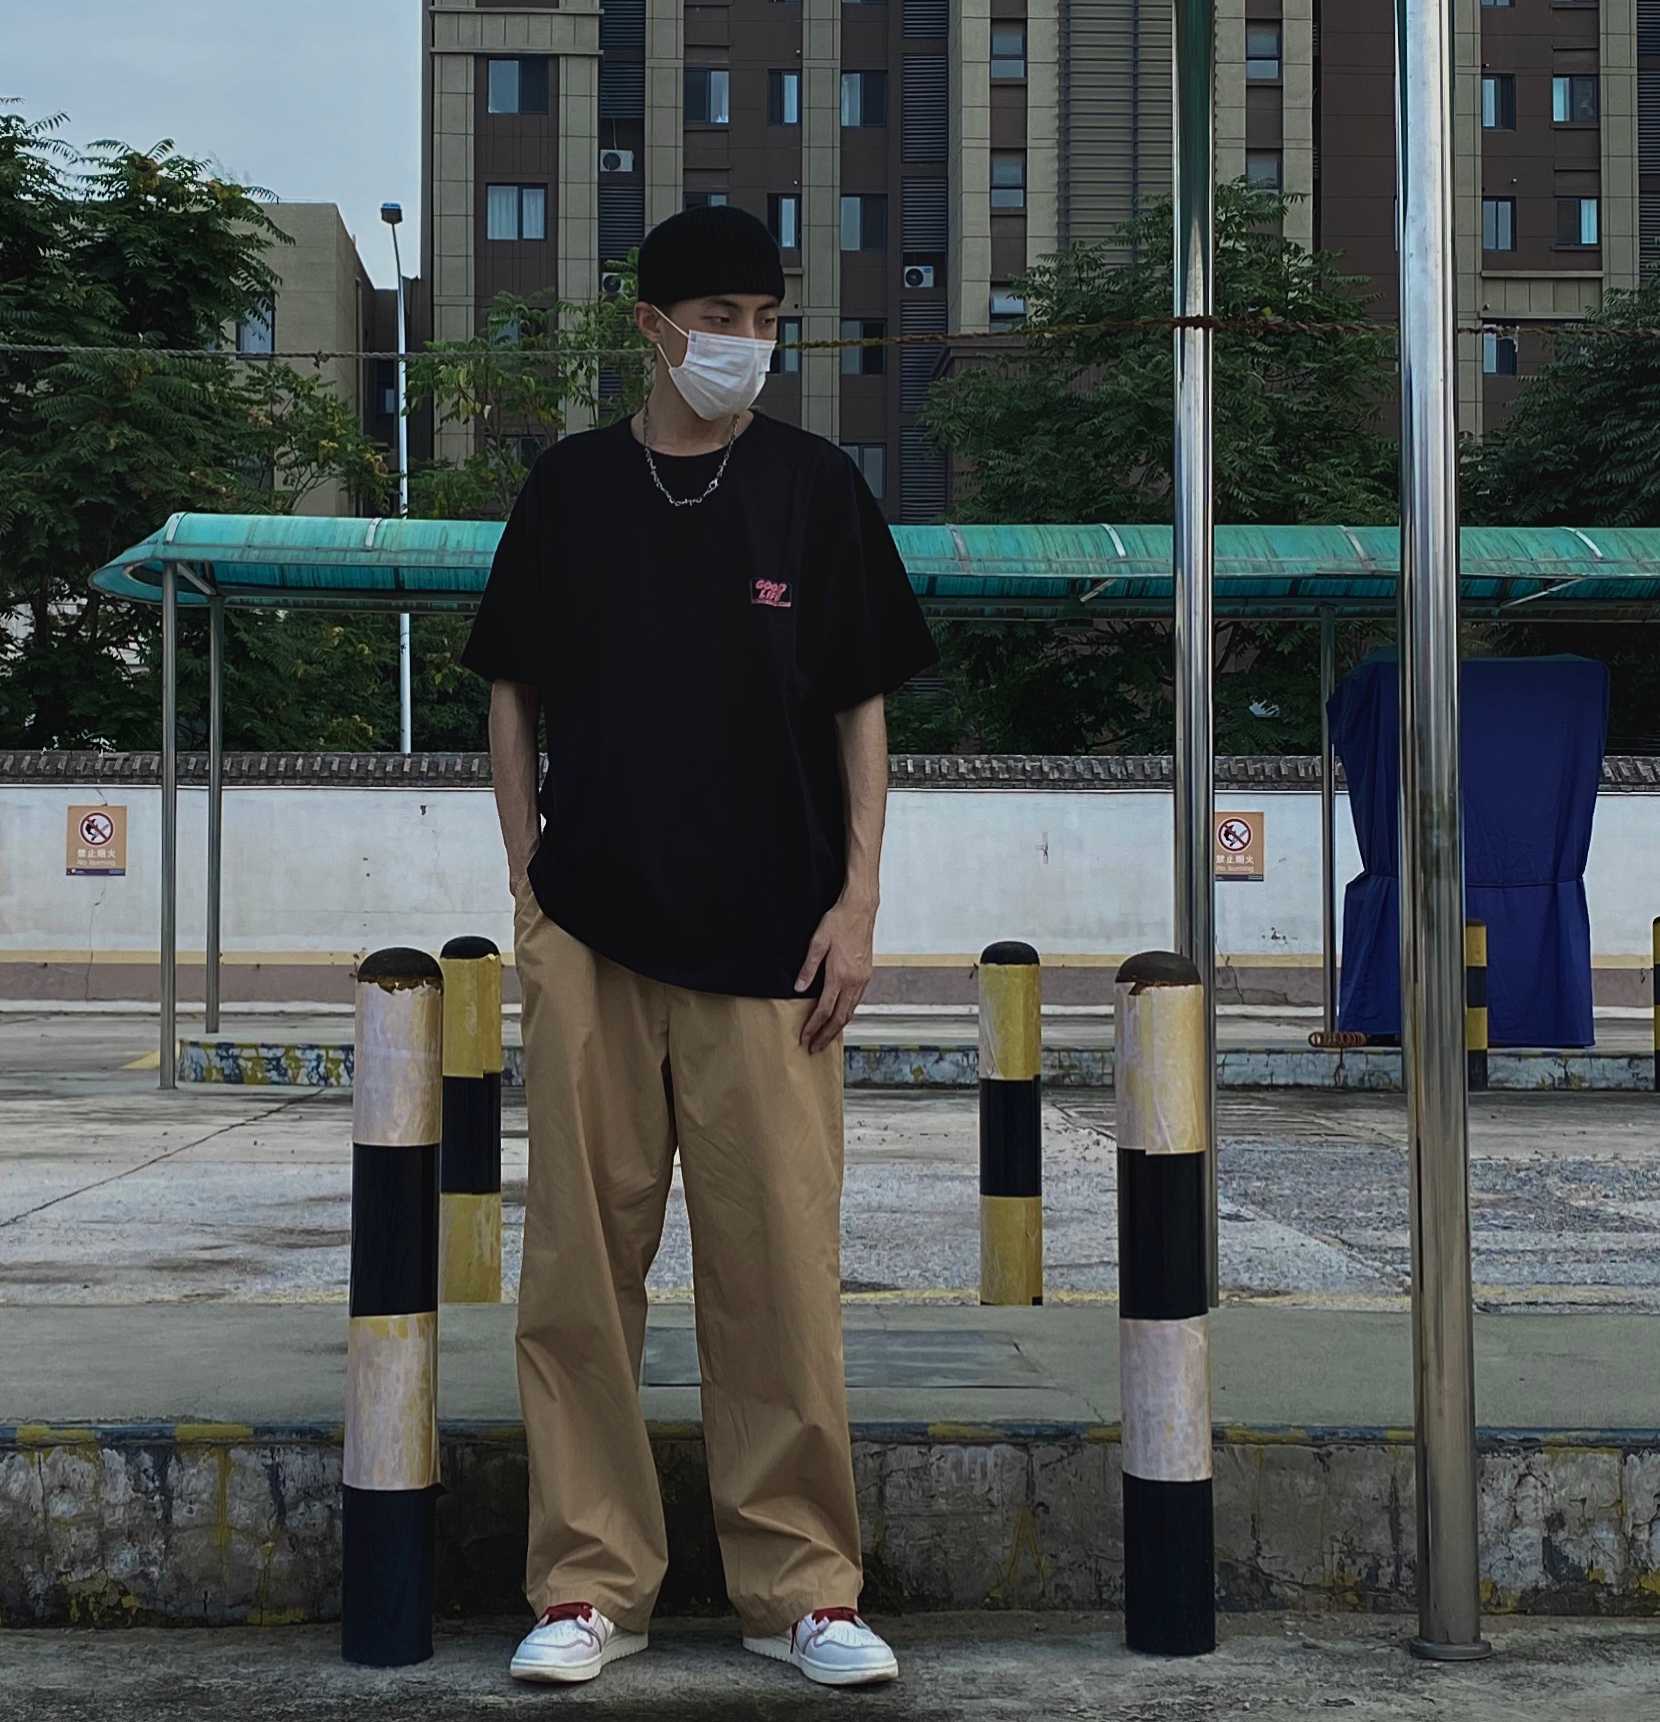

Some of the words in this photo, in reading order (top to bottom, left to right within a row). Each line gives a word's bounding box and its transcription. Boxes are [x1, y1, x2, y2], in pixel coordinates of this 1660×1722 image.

[755, 579, 787, 592] GOOD
[758, 589, 782, 601] LIFE
[77, 848, 116, 858] 禁止烟火
[1215, 854, 1254, 864] 禁止烟火
